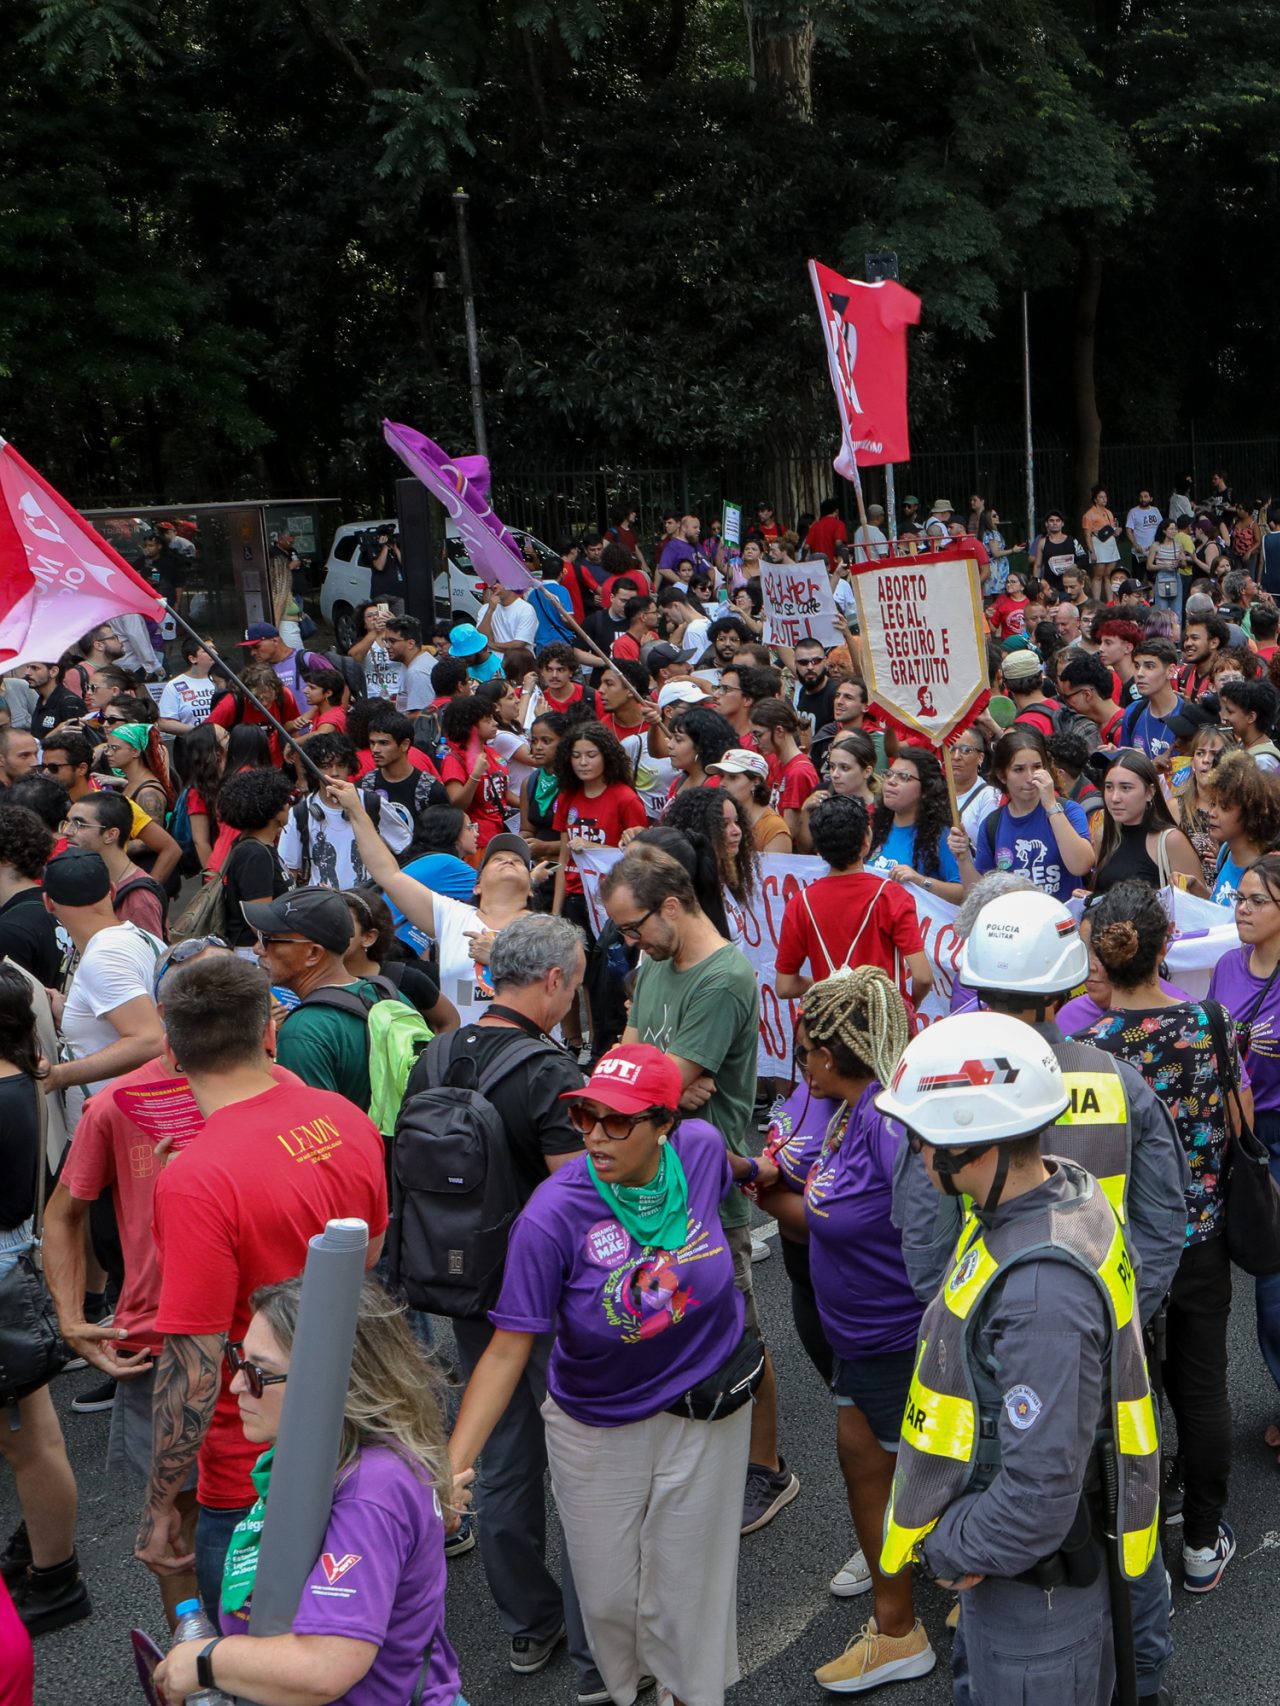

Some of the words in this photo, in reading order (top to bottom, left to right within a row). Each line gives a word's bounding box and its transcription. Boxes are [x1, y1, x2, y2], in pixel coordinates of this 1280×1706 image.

[878, 575, 927, 602] ABORTO
[881, 602, 927, 630] LEGAL,
[885, 629, 935, 658] SEGURO
[941, 628, 950, 655] E
[366, 673, 398, 684] FORCE
[891, 658, 950, 685] GRATUITO
[988, 932, 1014, 940] MILITAR
[1071, 1088, 1101, 1114] IA
[277, 1115, 341, 1157] LENIN
[590, 1224, 617, 1240] CRIANÇA
[594, 1233, 615, 1247] NÃO
[599, 1239, 626, 1260] MÃE
[906, 1395, 926, 1433] TAR
